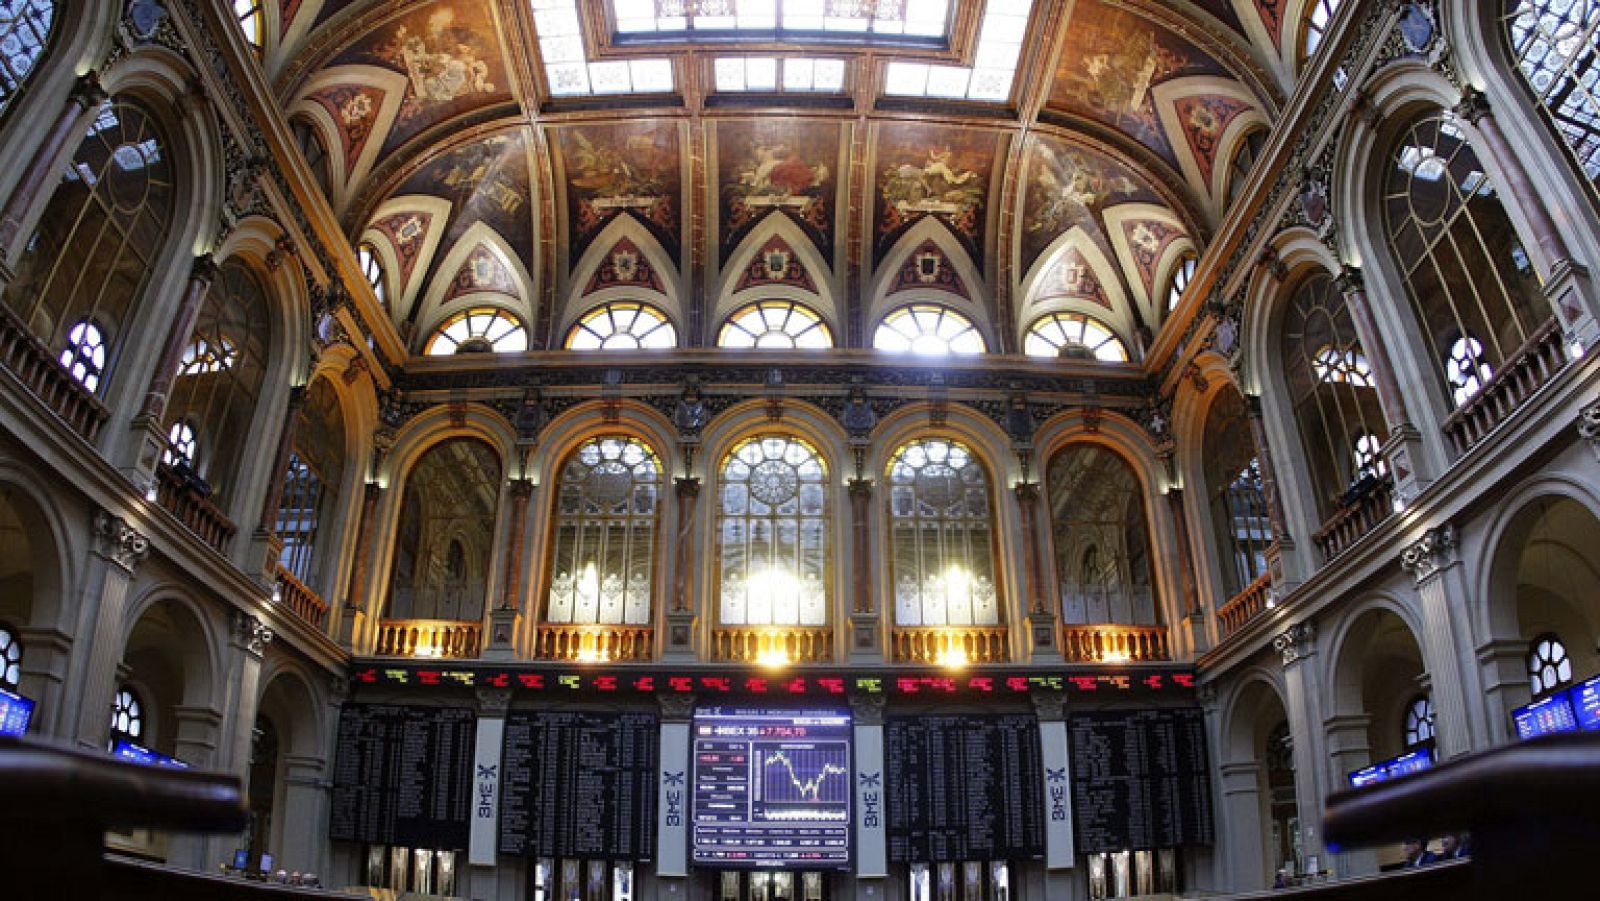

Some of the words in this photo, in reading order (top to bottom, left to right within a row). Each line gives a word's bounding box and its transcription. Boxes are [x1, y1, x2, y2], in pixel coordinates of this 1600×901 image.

[478, 782, 493, 819] BME
[666, 789, 680, 827] BME
[864, 791, 878, 828] BME
[1050, 785, 1066, 821] BME
